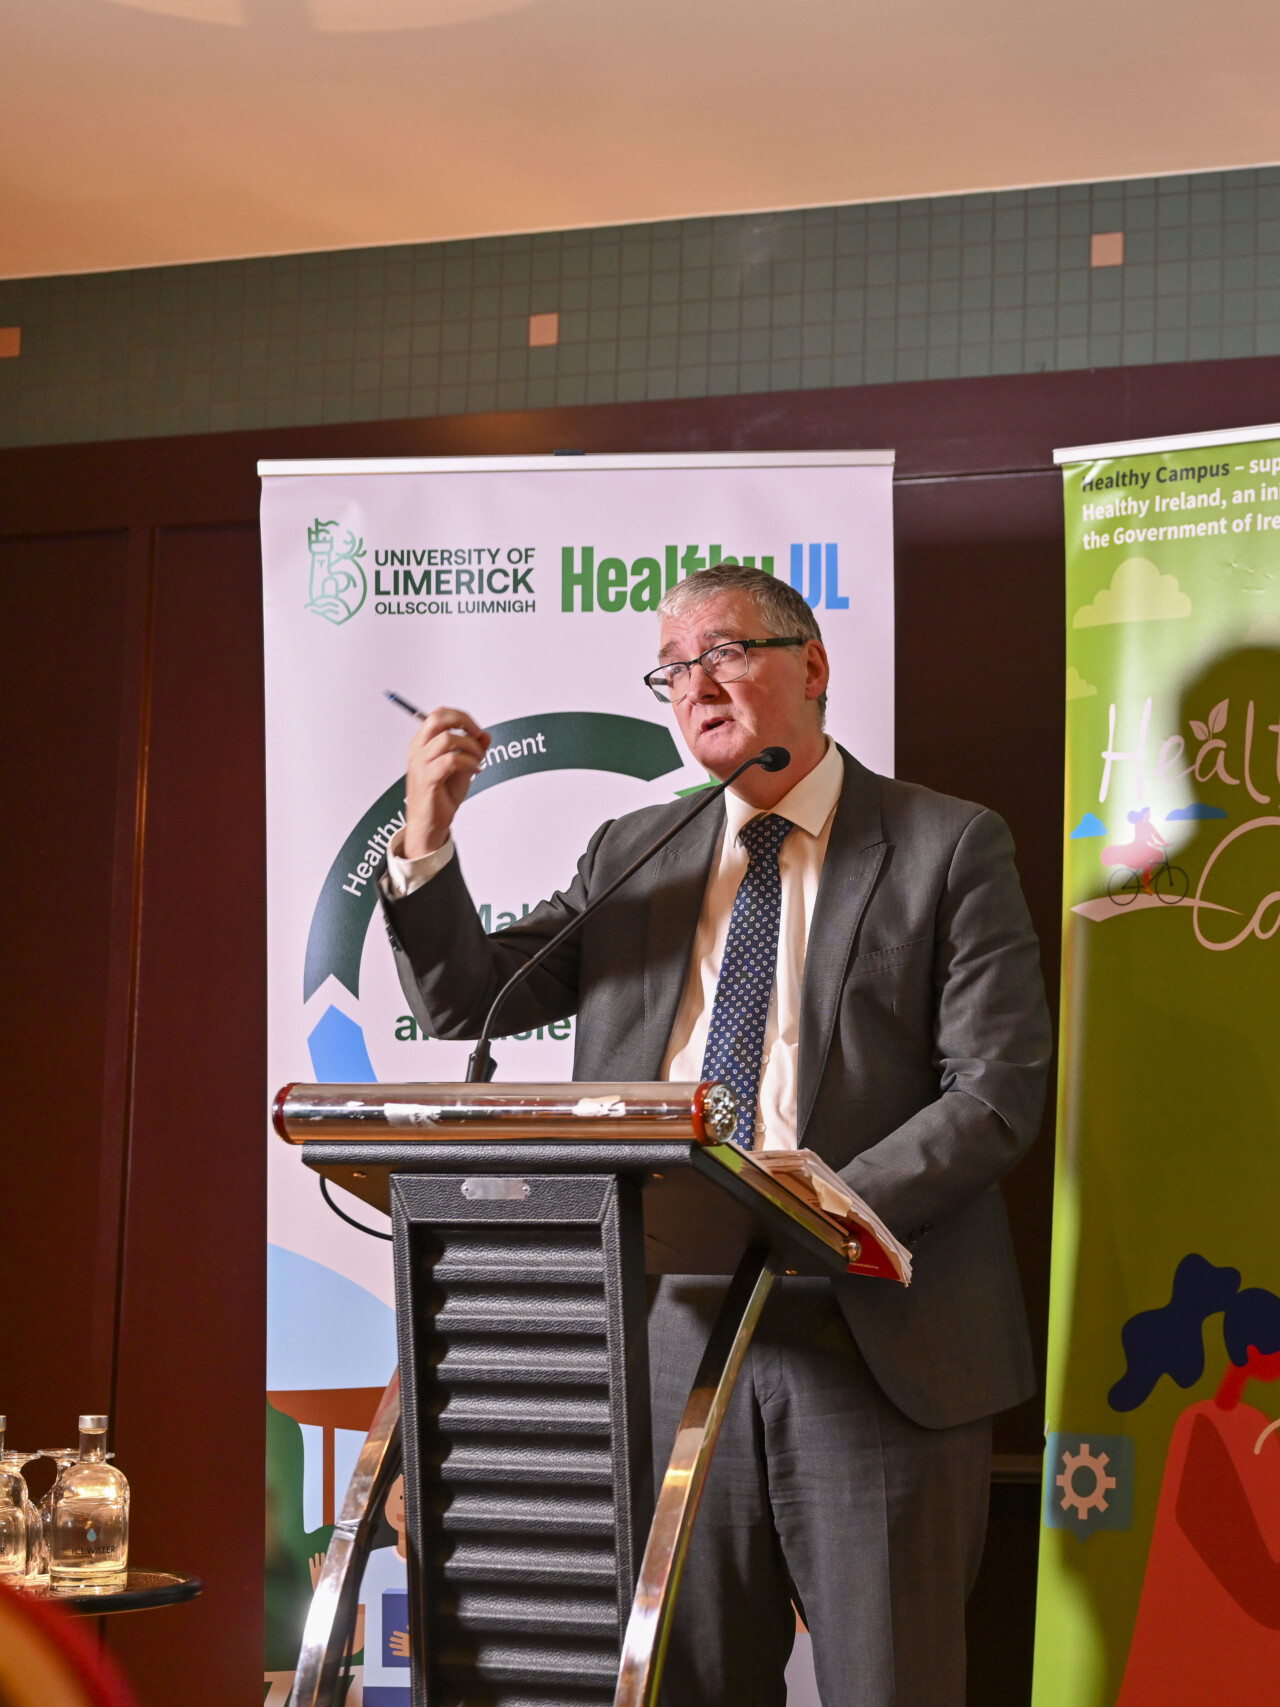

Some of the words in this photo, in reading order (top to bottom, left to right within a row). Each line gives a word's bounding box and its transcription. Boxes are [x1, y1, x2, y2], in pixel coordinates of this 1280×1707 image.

[1082, 470, 1150, 493] Healthy
[1156, 461, 1230, 484] Campus
[1082, 496, 1150, 522] Healthy
[1154, 487, 1227, 513] Ireland,
[1231, 486, 1256, 504] an
[1082, 530, 1110, 550] the
[1113, 517, 1227, 545] Government
[1231, 513, 1253, 532] of
[375, 548, 500, 567] UNIVERSITY
[507, 547, 536, 565] OF
[374, 568, 535, 596] LIMERICK
[790, 543, 850, 610] UL
[375, 601, 453, 615] OLLSCOIL
[458, 600, 536, 614] LUIMNIGH
